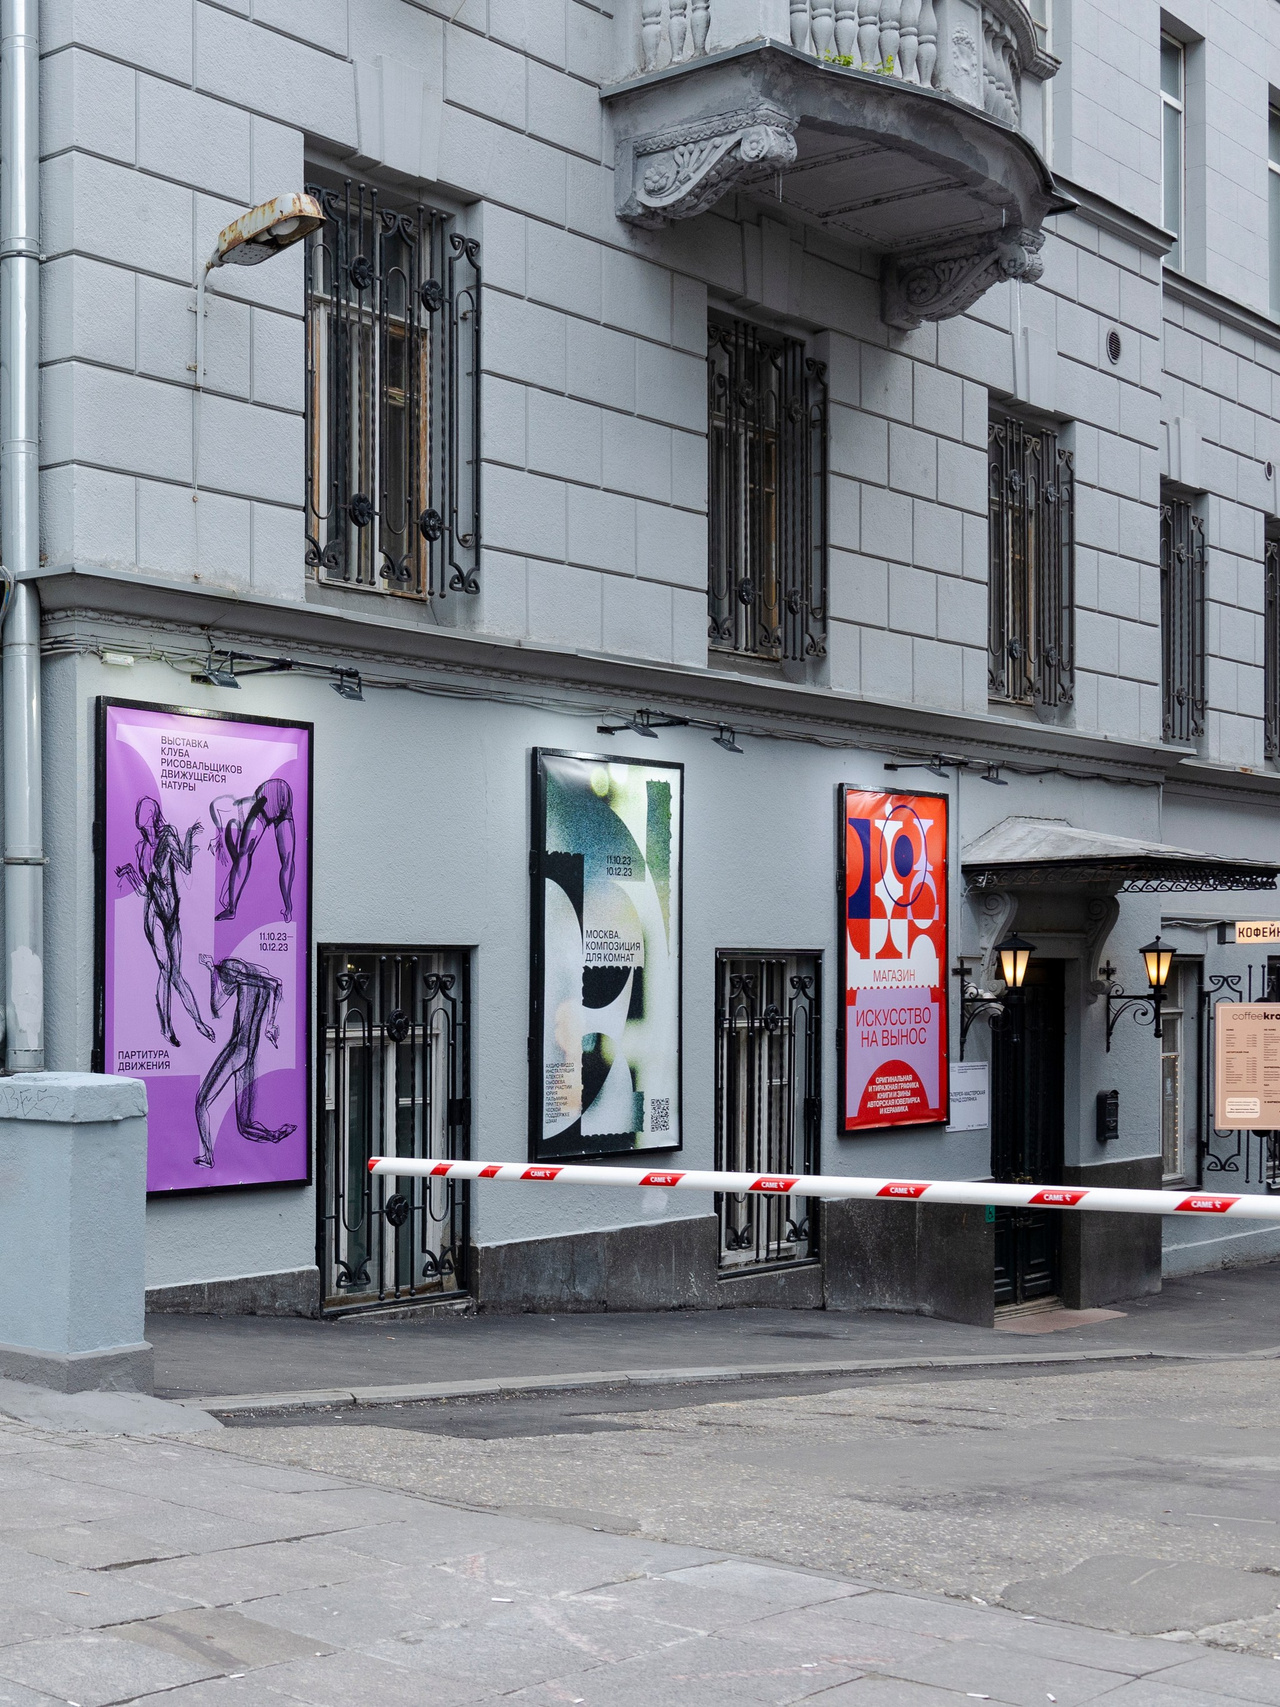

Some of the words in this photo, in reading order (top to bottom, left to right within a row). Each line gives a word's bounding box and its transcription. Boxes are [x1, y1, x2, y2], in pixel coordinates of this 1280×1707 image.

[161, 735, 209, 749] ВЫСТАВКА
[161, 747, 190, 758] КЛУБА
[161, 758, 243, 774] РИСОВАЛЬЩИКОВ
[161, 769, 227, 783] ДВИЖУЩЕЙСЯ
[161, 780, 196, 791] НАТУРЫ
[606, 867, 632, 876] 10.12.23
[259, 942, 288, 951] 10.12.23
[585, 941, 640, 953] КОМПОЗИЦИЯ
[585, 953, 603, 963] ДЛЯ
[603, 953, 634, 963] КОМНАТ
[873, 969, 916, 982] МАГАЗИН
[856, 1007, 931, 1027] ИСКУССТВО
[861, 1030, 879, 1048] НА
[881, 1027, 927, 1046] ВЫНОС
[118, 1050, 170, 1059] ПАРТИТУРА
[118, 1061, 170, 1072] ДВИЖЕНИЯ
[1191, 1200, 1213, 1208] CAME
